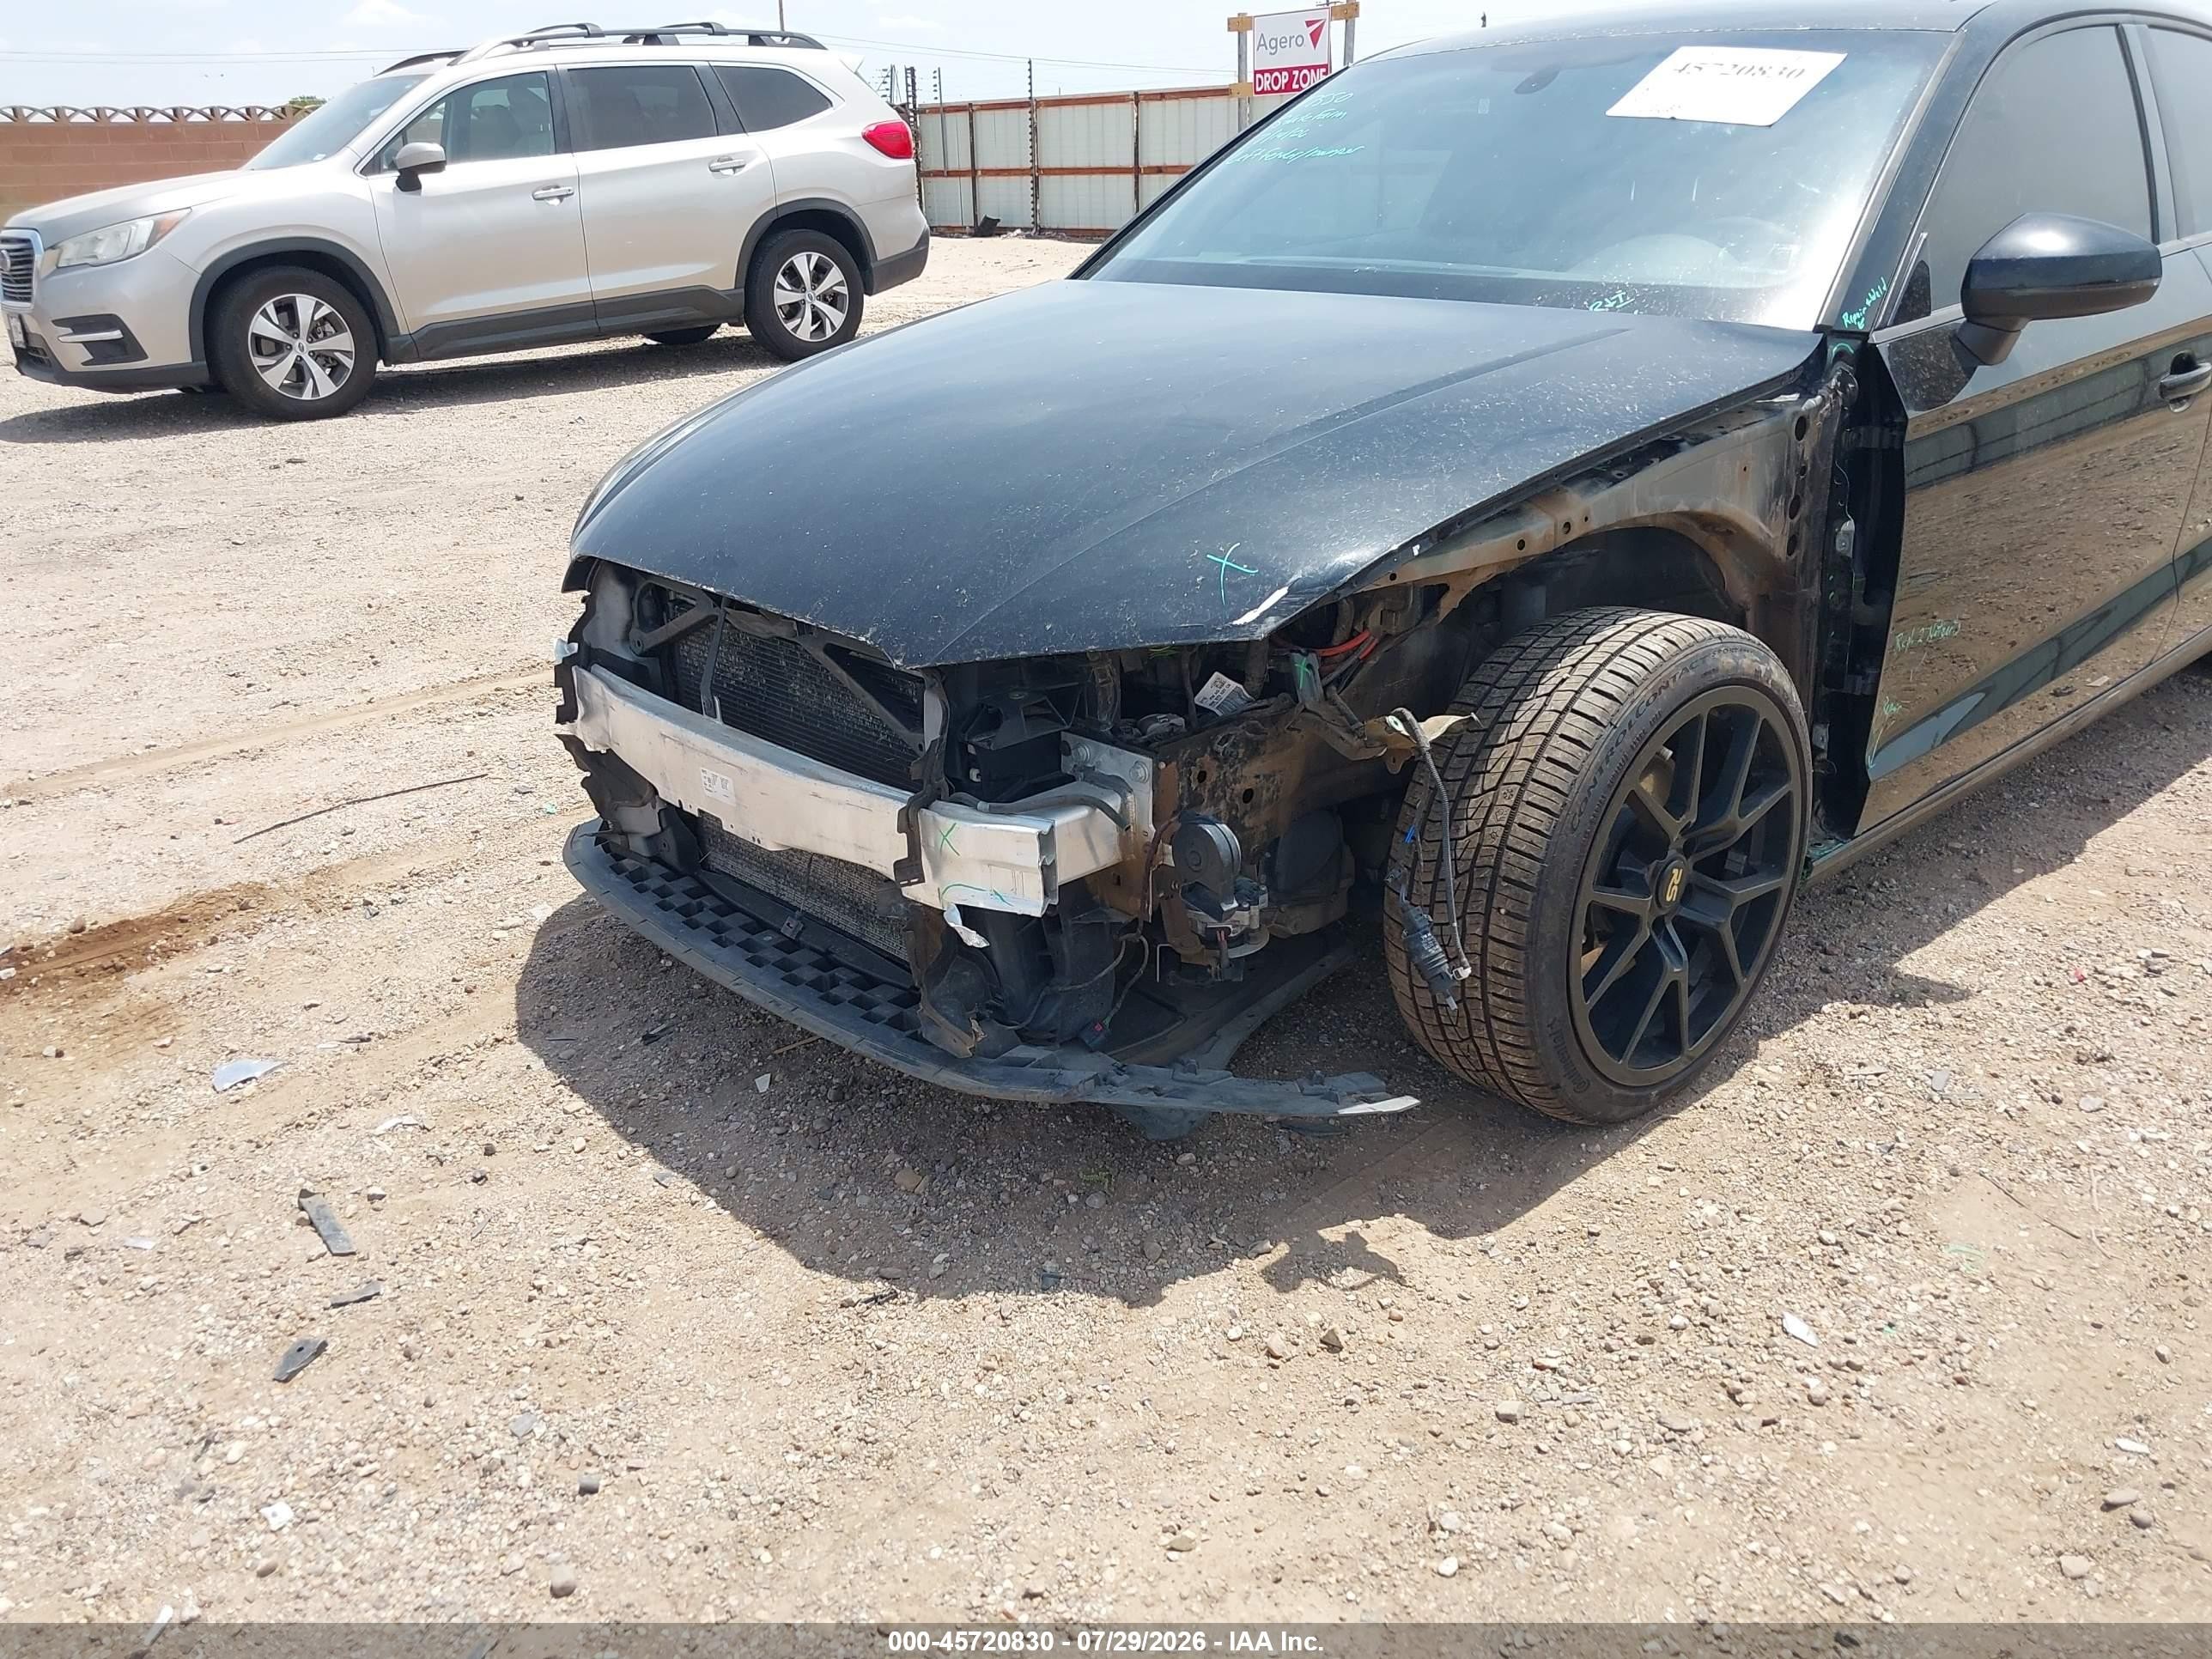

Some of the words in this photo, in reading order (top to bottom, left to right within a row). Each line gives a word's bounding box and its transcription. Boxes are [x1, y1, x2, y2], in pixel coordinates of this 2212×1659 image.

[1256, 33, 1304, 55] Agero
[1255, 70, 1289, 92] DROP
[1292, 68, 1327, 89] ZONE
[1665, 868, 1683, 902] RS
